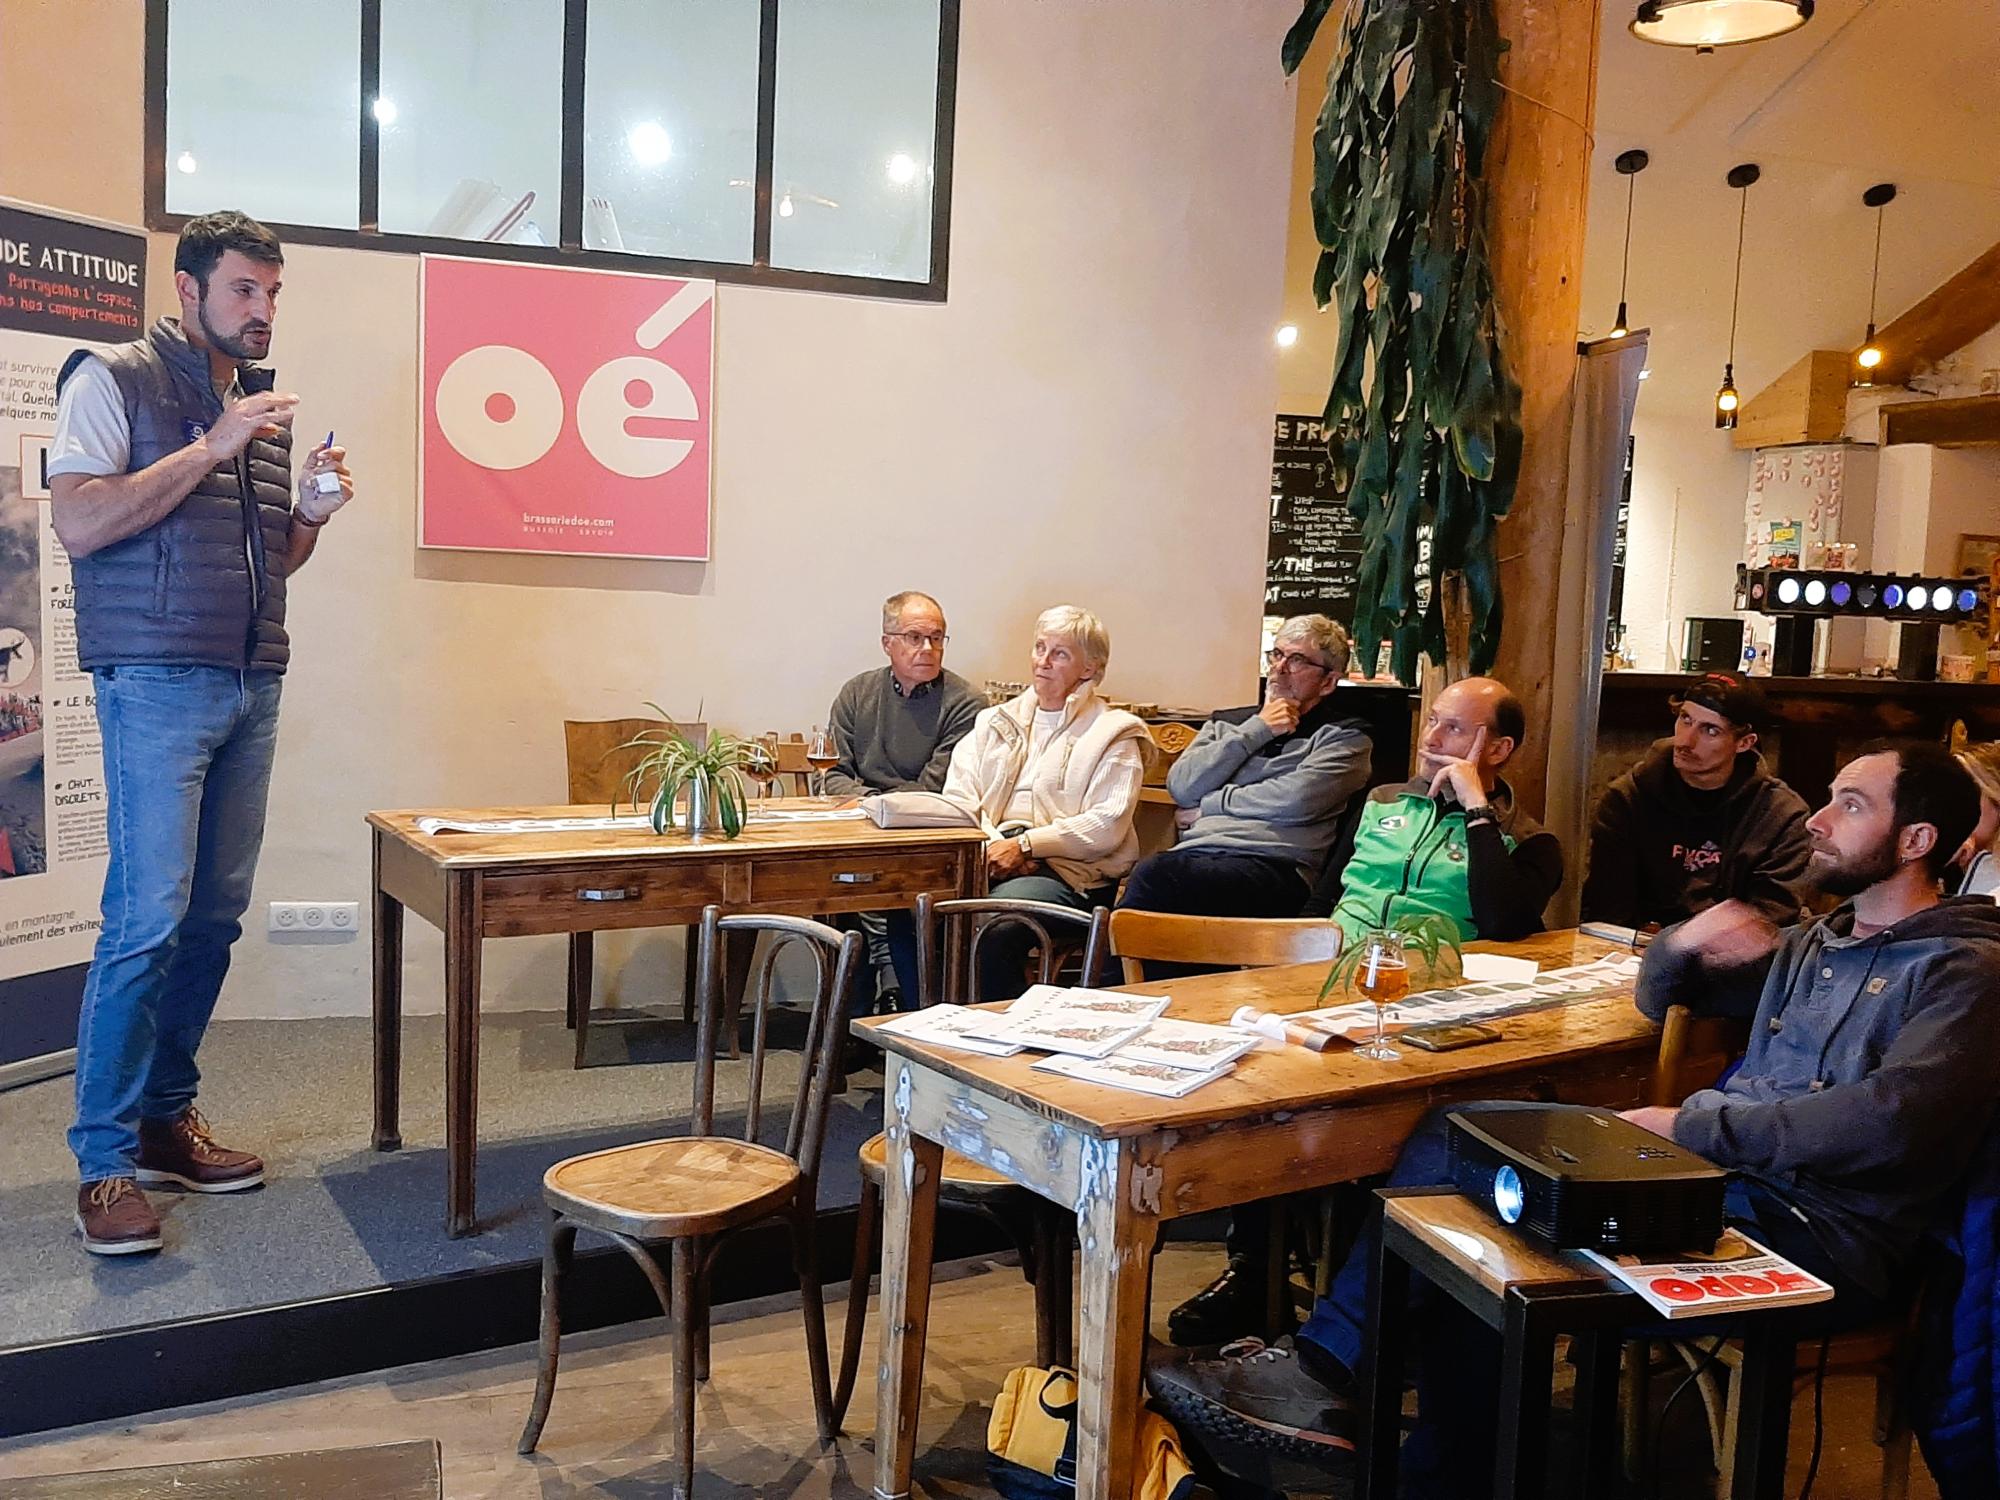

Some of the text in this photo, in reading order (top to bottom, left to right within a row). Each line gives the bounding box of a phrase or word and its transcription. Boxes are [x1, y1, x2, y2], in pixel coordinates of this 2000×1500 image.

[39, 247, 138, 287] ATTITUDE
[11, 362, 58, 376] survivre
[9, 377, 36, 391] pour
[435, 281, 714, 479] oé
[21, 910, 76, 925] montagne
[46, 925, 66, 938] des
